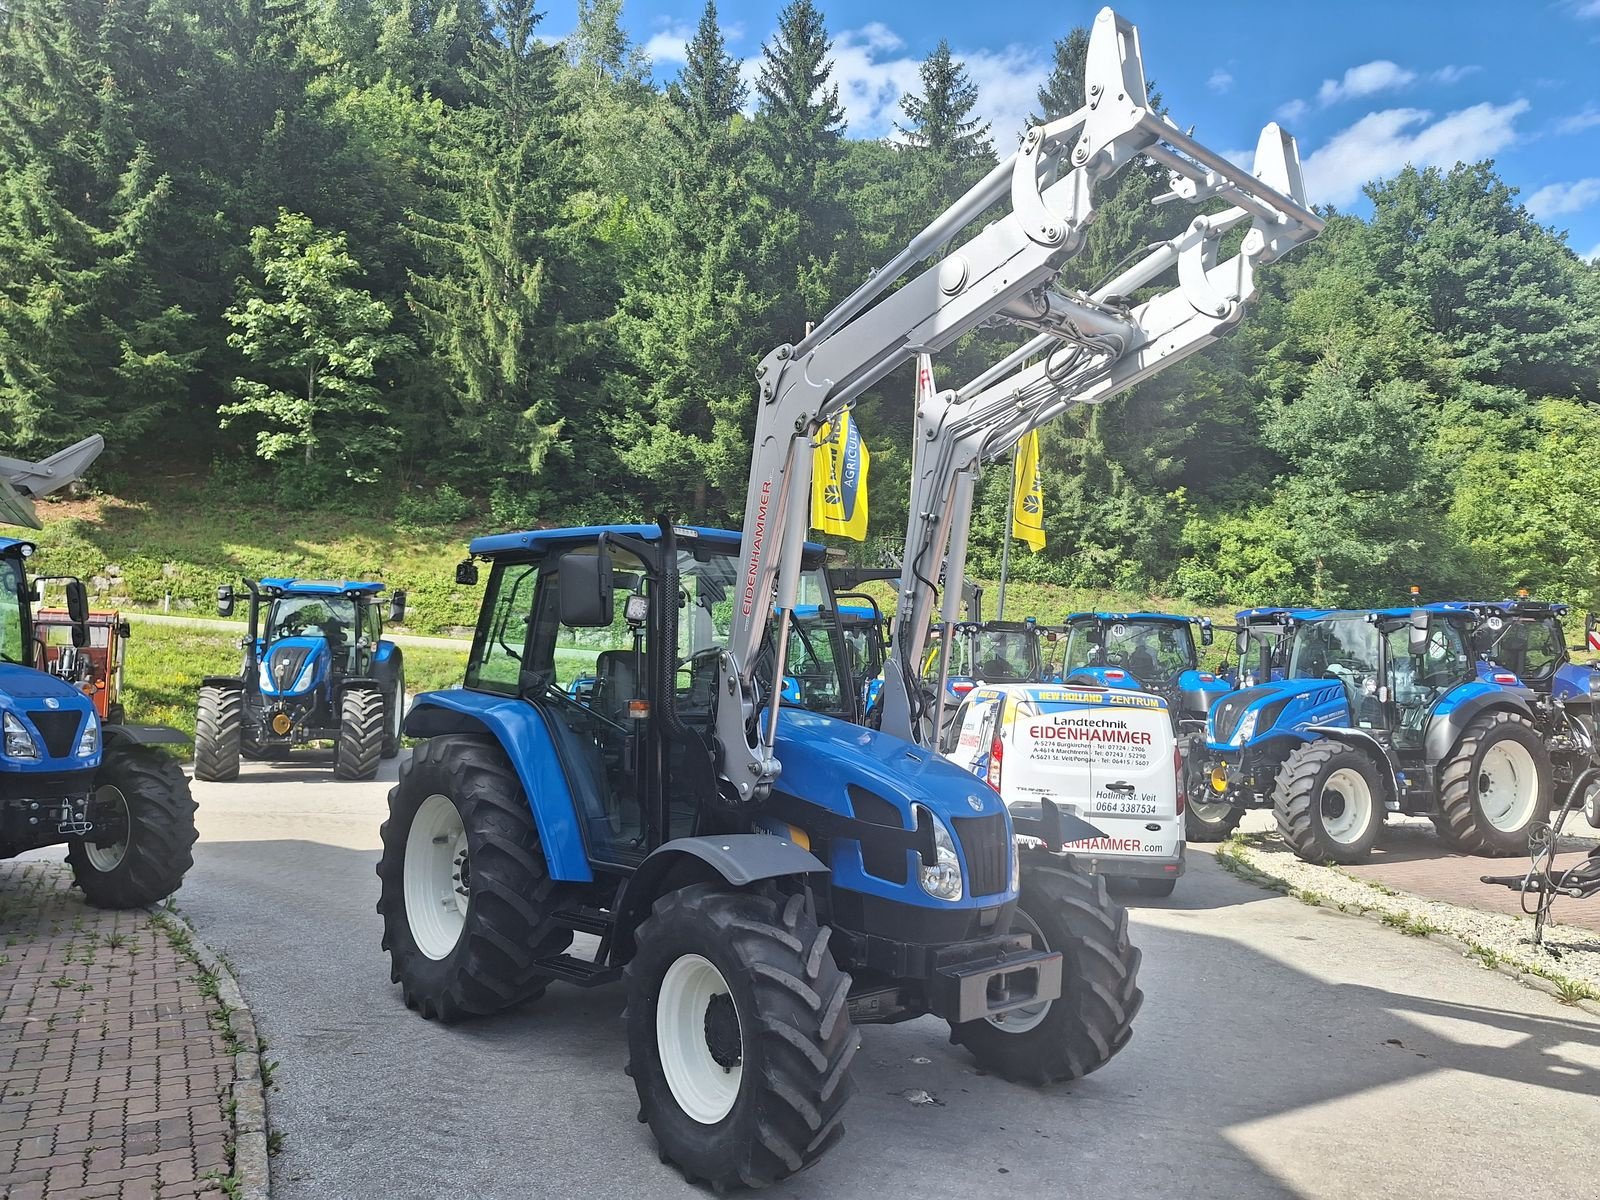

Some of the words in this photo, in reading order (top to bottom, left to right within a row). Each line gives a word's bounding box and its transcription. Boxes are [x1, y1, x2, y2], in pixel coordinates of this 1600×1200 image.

[742, 481, 771, 617] EIDENHAMMER
[1490, 618, 1500, 627] 50
[1113, 626, 1124, 635] 40
[1038, 691, 1062, 701] NEW
[1062, 692, 1103, 703] HOLLAND
[1109, 694, 1159, 707] ZENTRUM
[1054, 716, 1128, 729] Landtechnik
[1029, 725, 1151, 745] EIDENHAMMER
[1056, 741, 1092, 749] Burgkirchen
[1128, 752, 1147, 760] 52290
[1095, 790, 1126, 800] Hotline
[1127, 792, 1139, 801] St.
[1140, 793, 1156, 802] Veit
[1095, 801, 1118, 812] 0664
[1119, 802, 1157, 814] 3387534
